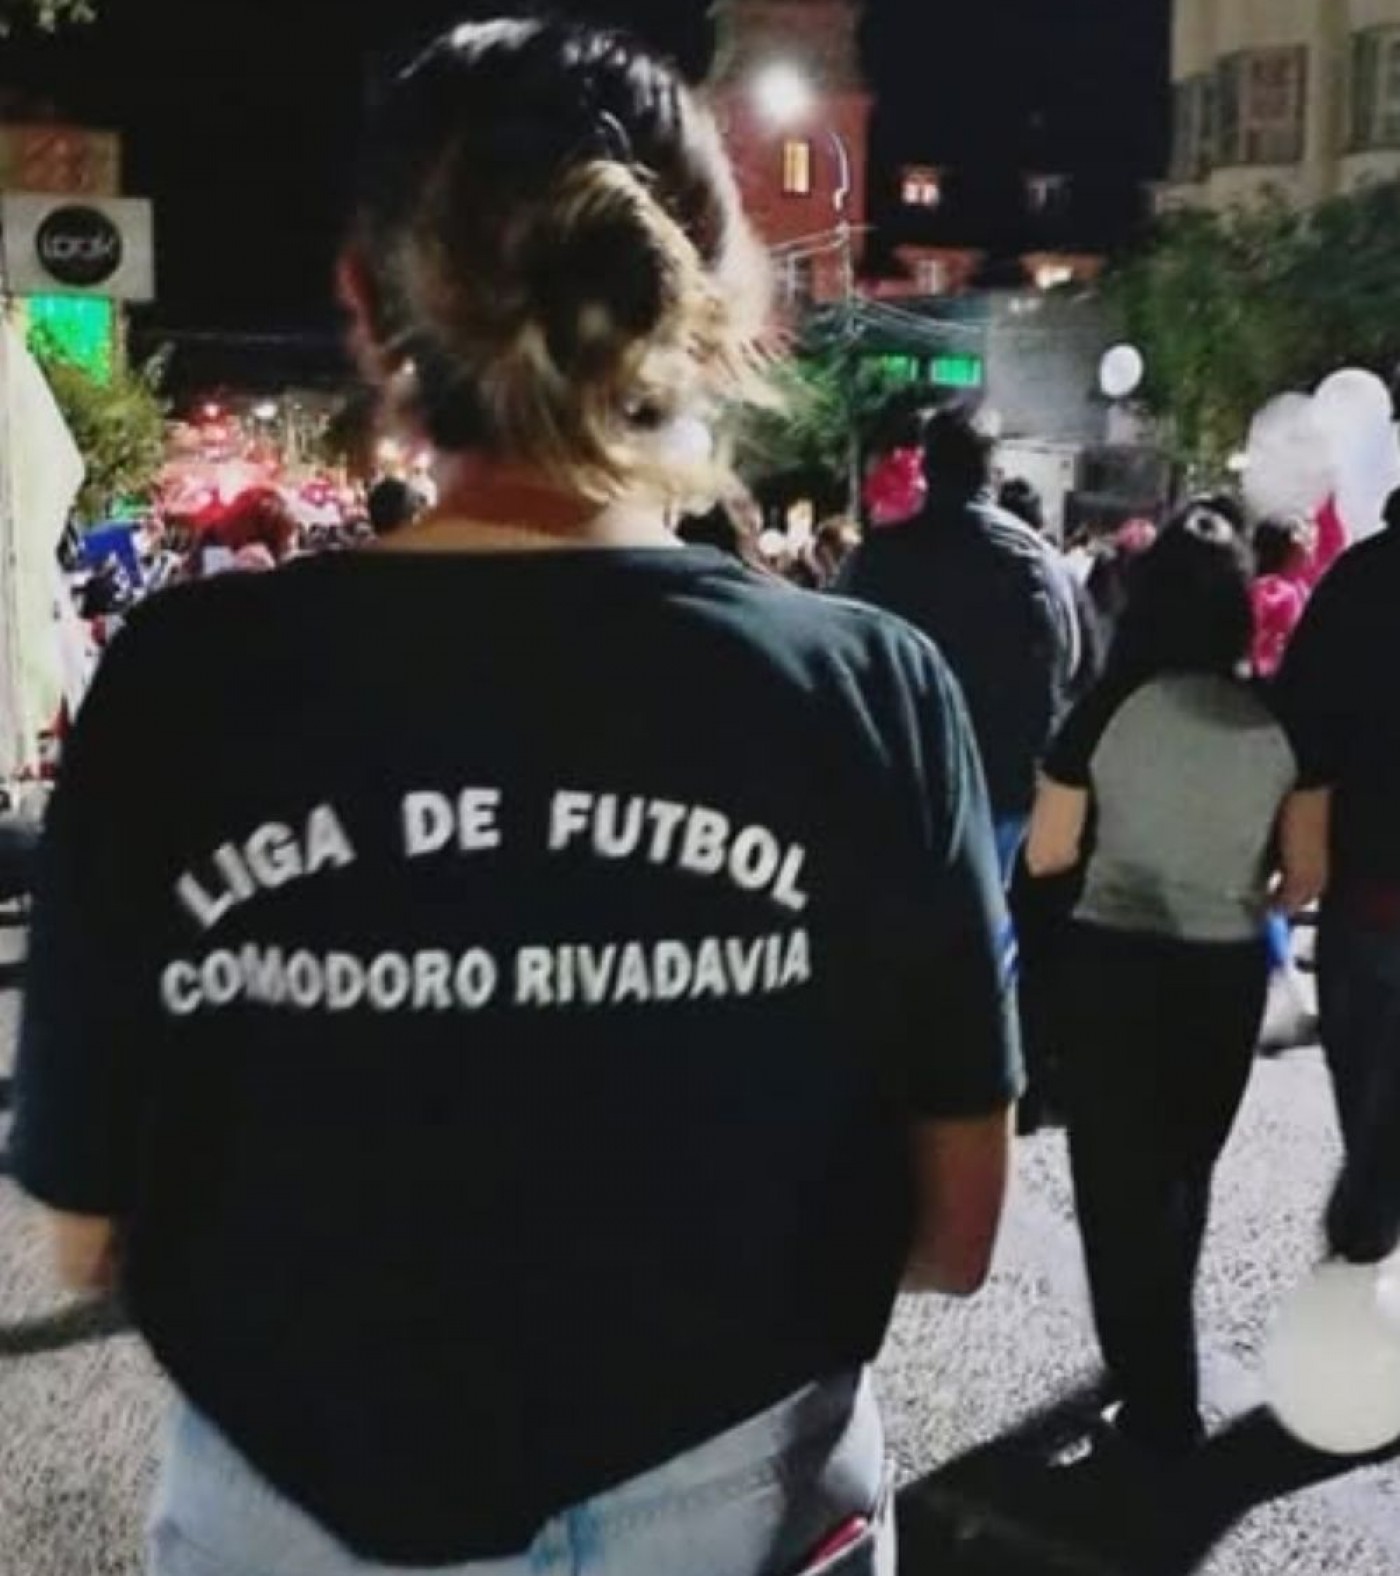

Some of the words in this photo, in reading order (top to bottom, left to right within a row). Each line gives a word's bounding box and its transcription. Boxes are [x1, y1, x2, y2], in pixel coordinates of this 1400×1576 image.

[176, 803, 356, 928] LIGA
[402, 788, 501, 858] DE
[549, 789, 807, 911] FUTBOL
[161, 942, 498, 1014] COMODORO
[515, 928, 810, 1003] RIVADAVIA
